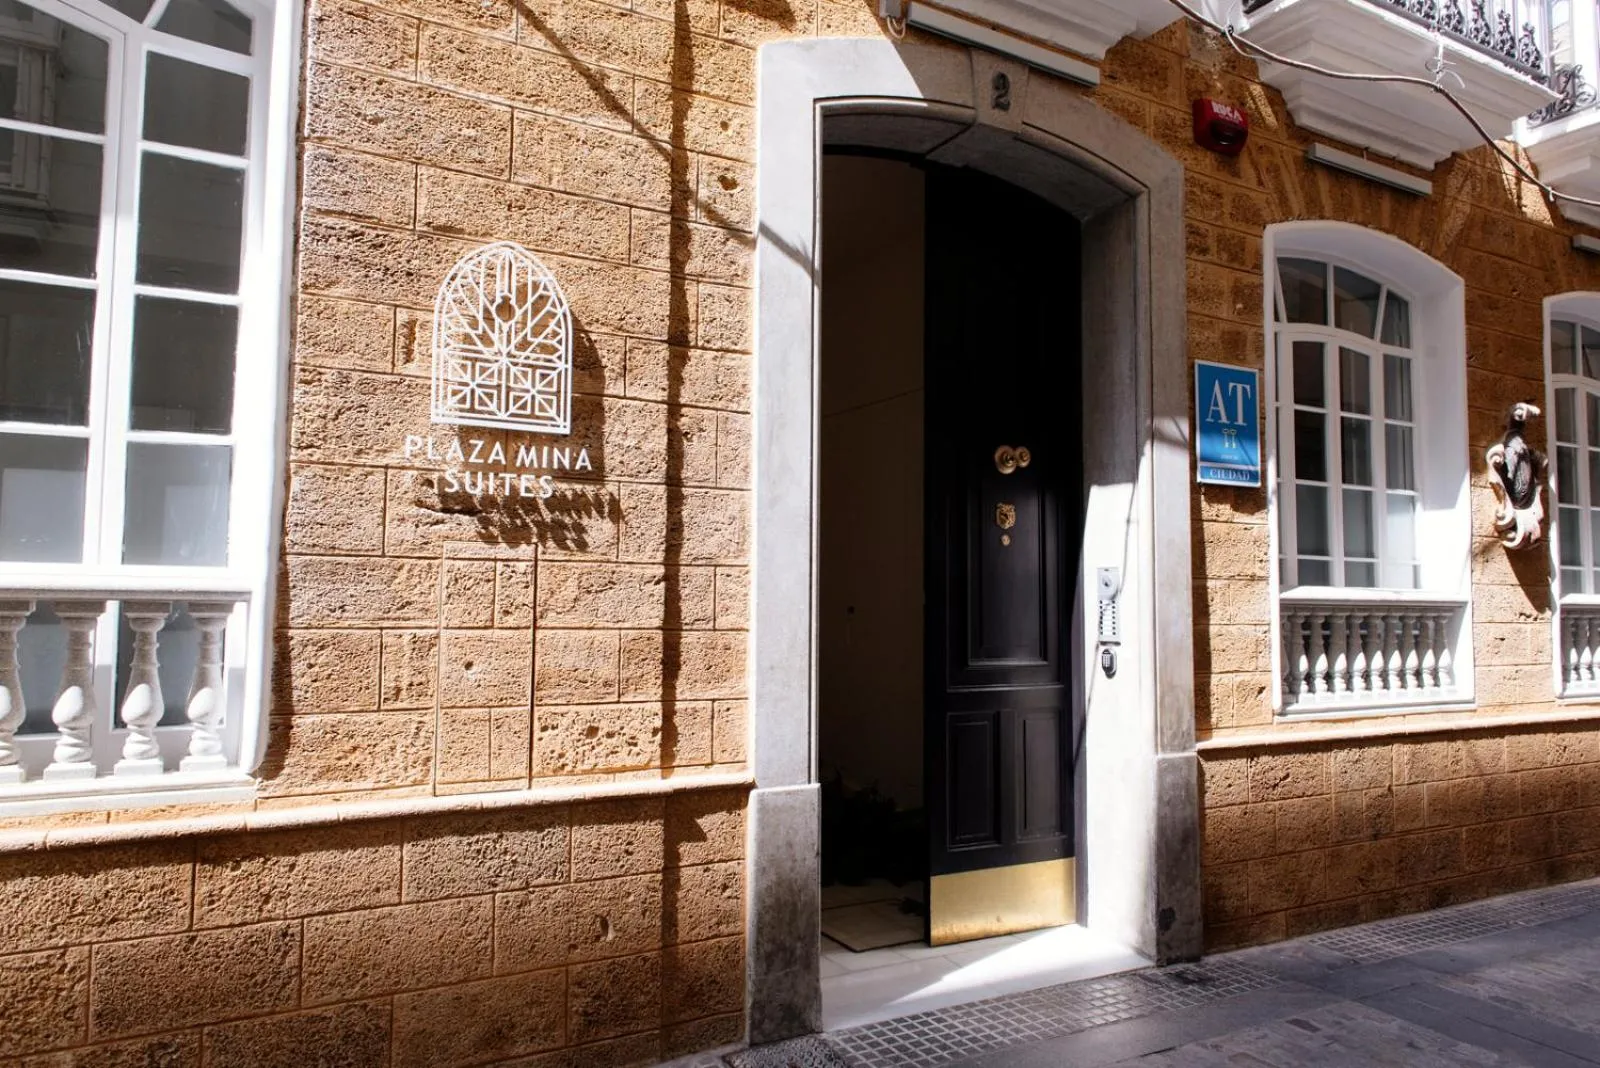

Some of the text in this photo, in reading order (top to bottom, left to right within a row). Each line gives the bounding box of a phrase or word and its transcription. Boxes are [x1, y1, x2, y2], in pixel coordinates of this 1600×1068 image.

[992, 71, 1010, 111] 2
[1205, 379, 1251, 426] AT
[404, 434, 592, 471] PLAZA MINA
[444, 468, 553, 499] SUITES
[1210, 468, 1250, 481] CIUDAD
